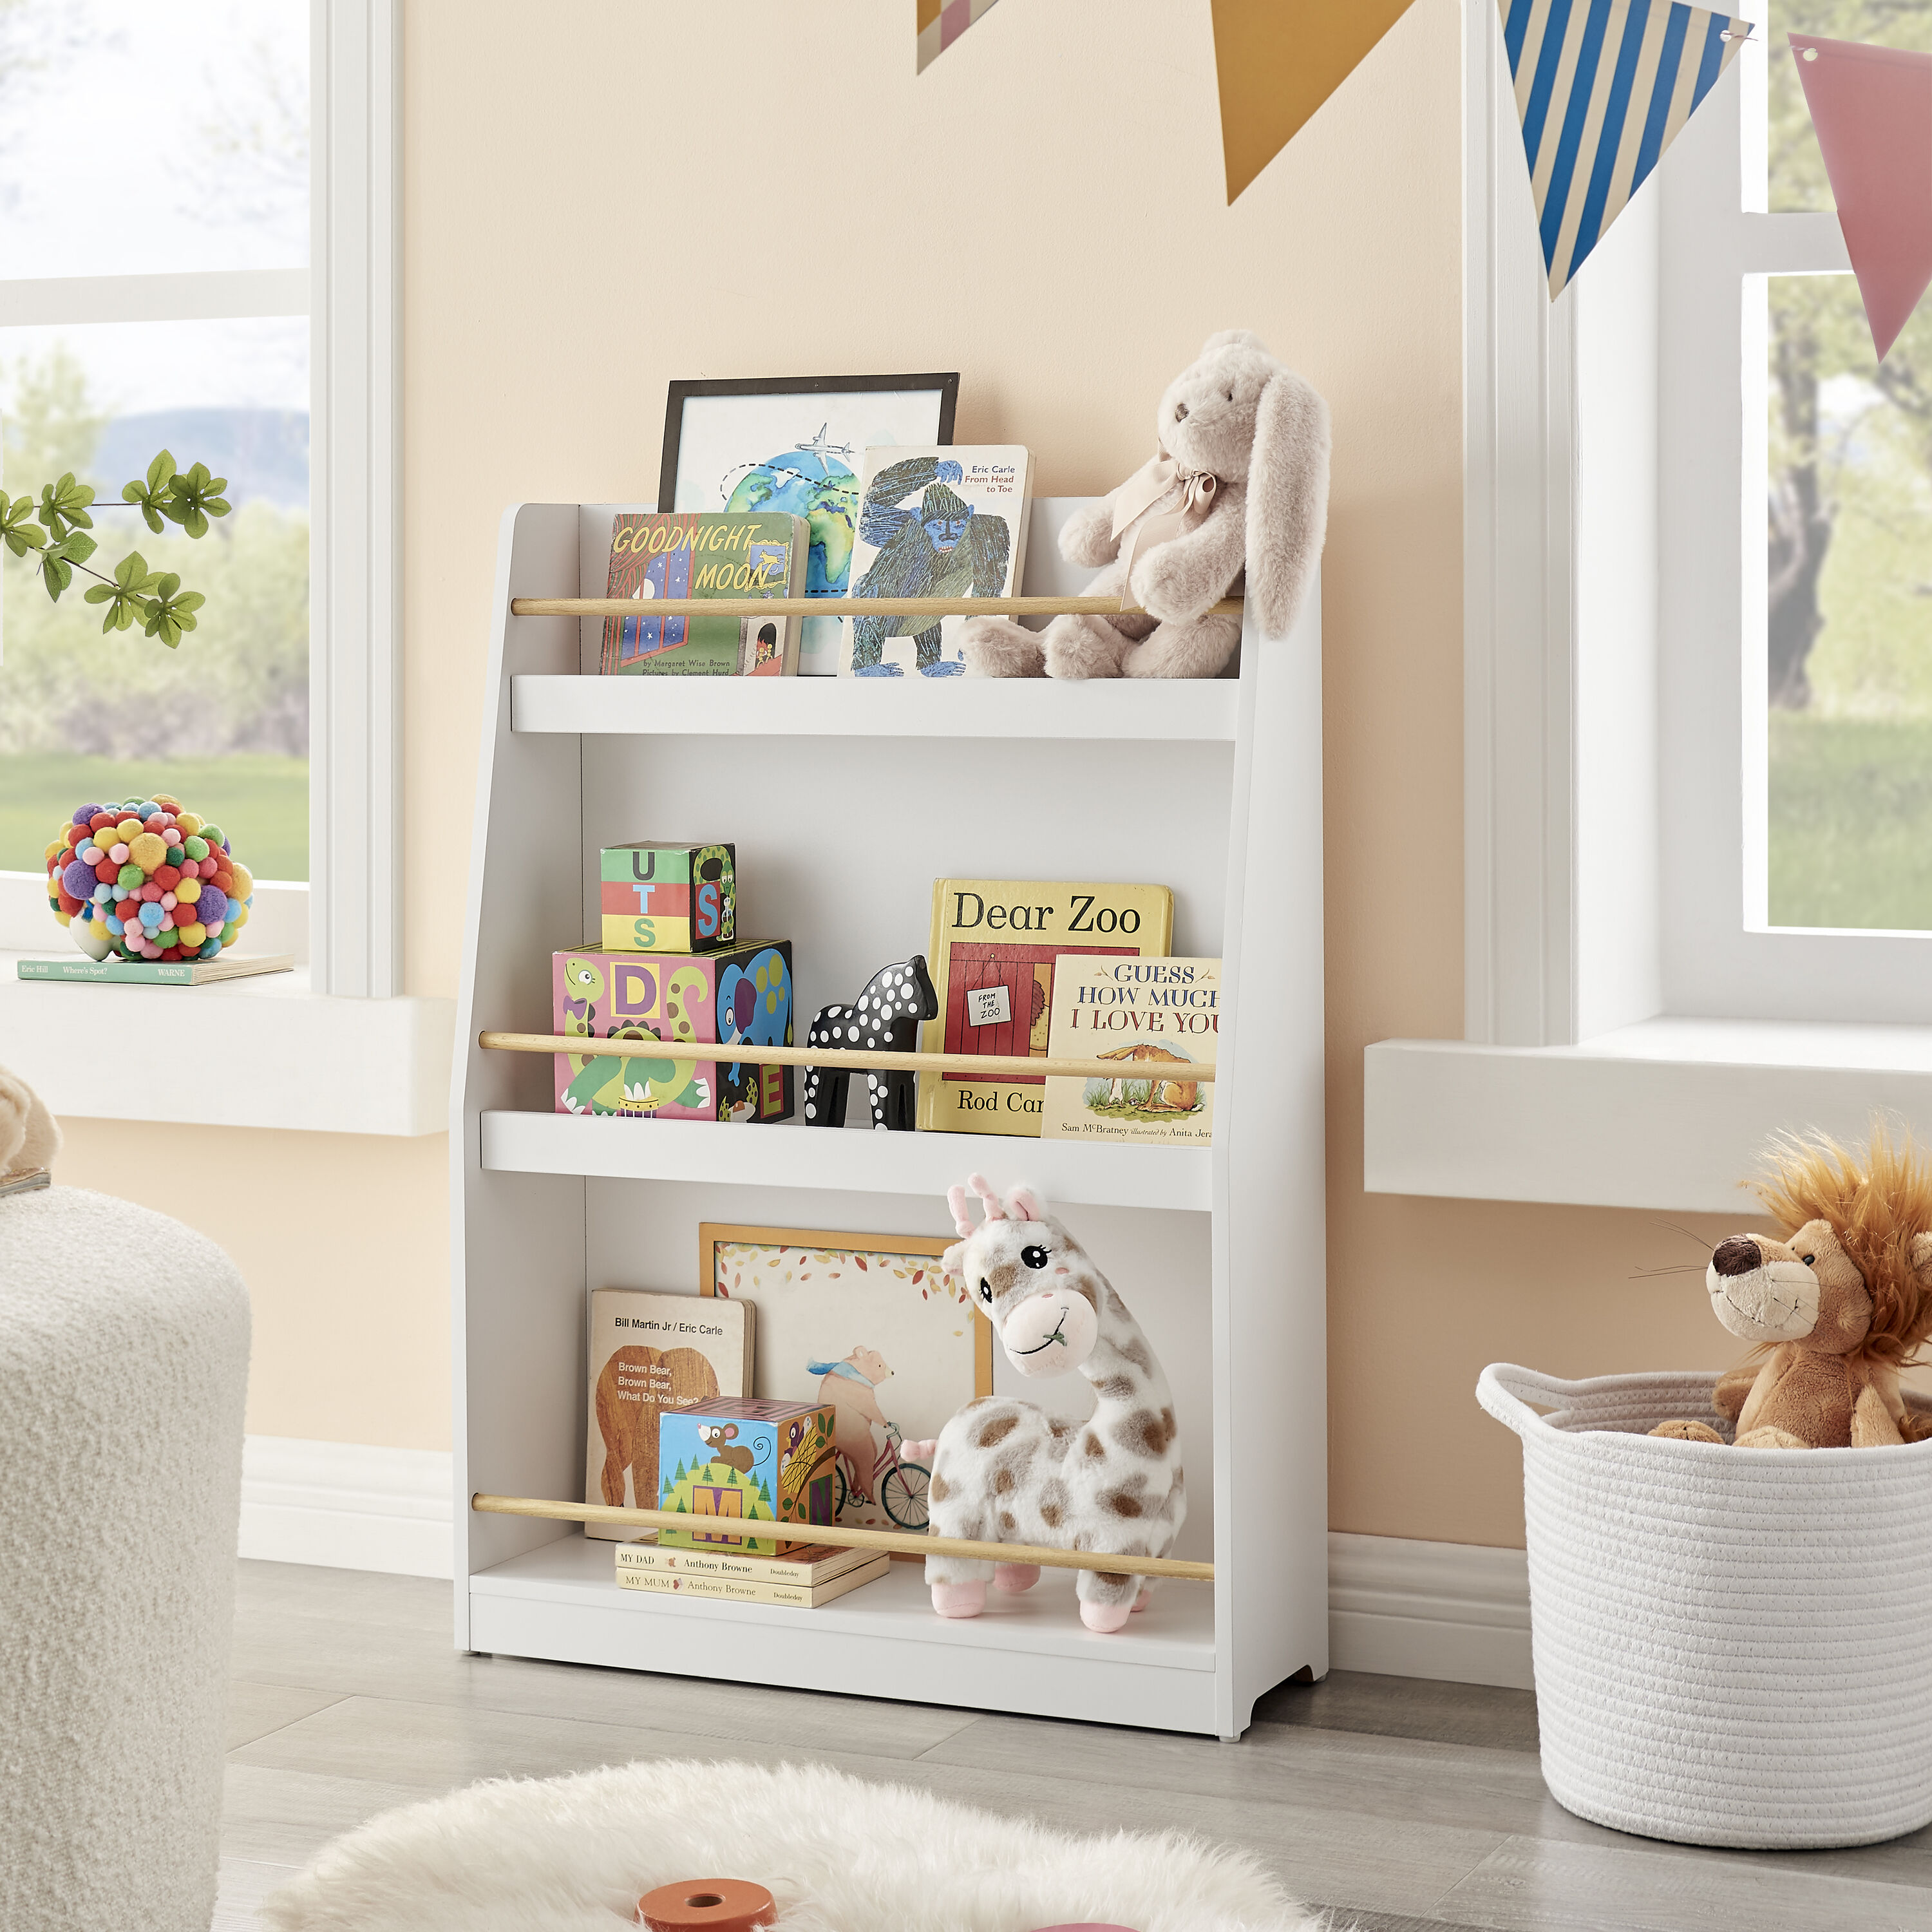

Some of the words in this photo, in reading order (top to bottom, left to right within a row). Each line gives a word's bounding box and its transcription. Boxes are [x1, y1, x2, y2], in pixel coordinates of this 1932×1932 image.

[613, 524, 762, 554] GOODNIGHT
[694, 563, 773, 591] MOON
[643, 659, 652, 668] by
[654, 659, 685, 668] Margaret
[632, 851, 655, 880] U
[632, 884, 656, 914] T
[698, 884, 719, 936] S
[951, 892, 1054, 931] Dear
[1068, 895, 1141, 934] Zoo
[633, 918, 656, 947] S
[62, 966, 89, 974] Where's
[90, 967, 108, 976] Spot?
[158, 969, 185, 977] WARNE
[1114, 963, 1195, 984] GUESS
[614, 964, 657, 1016] D
[978, 992, 996, 1003] FROM
[1077, 986, 1141, 1005] HOW
[1148, 989, 1220, 1008] MUCH
[980, 1007, 1000, 1019] ZOO
[983, 999, 995, 1009] THE
[1070, 1009, 1080, 1029] I
[1091, 1009, 1164, 1032] LOVE
[762, 1065, 781, 1115] E
[957, 1090, 998, 1111] Rod
[1061, 1122, 1079, 1132] Sam
[1160, 1128, 1167, 1137] by
[1169, 1128, 1192, 1137] Anita
[615, 1318, 629, 1327] Bill
[632, 1319, 659, 1330] Martin
[662, 1321, 671, 1331] Jr
[679, 1323, 697, 1333] Eric
[699, 1325, 723, 1335] Carle
[618, 1362, 647, 1374] Brown
[650, 1365, 672, 1377] Bear,
[618, 1376, 647, 1387] Brown
[649, 1379, 672, 1391] Bear,
[617, 1390, 640, 1401] What
[643, 1393, 655, 1403] Do
[658, 1394, 674, 1404] You
[676, 1396, 699, 1405] See?
[811, 1477, 831, 1526] N
[694, 1488, 741, 1543] M
[620, 1553, 633, 1562] MY
[636, 1555, 654, 1565] DAD
[685, 1558, 719, 1572] Anthony
[722, 1562, 753, 1573] Browne
[770, 1568, 799, 1578] Doubleday
[626, 1576, 641, 1585] MY
[644, 1577, 670, 1588] MUM
[687, 1580, 723, 1594] Anthony
[726, 1584, 756, 1596] Browne
[773, 1592, 803, 1602] Doubleday
